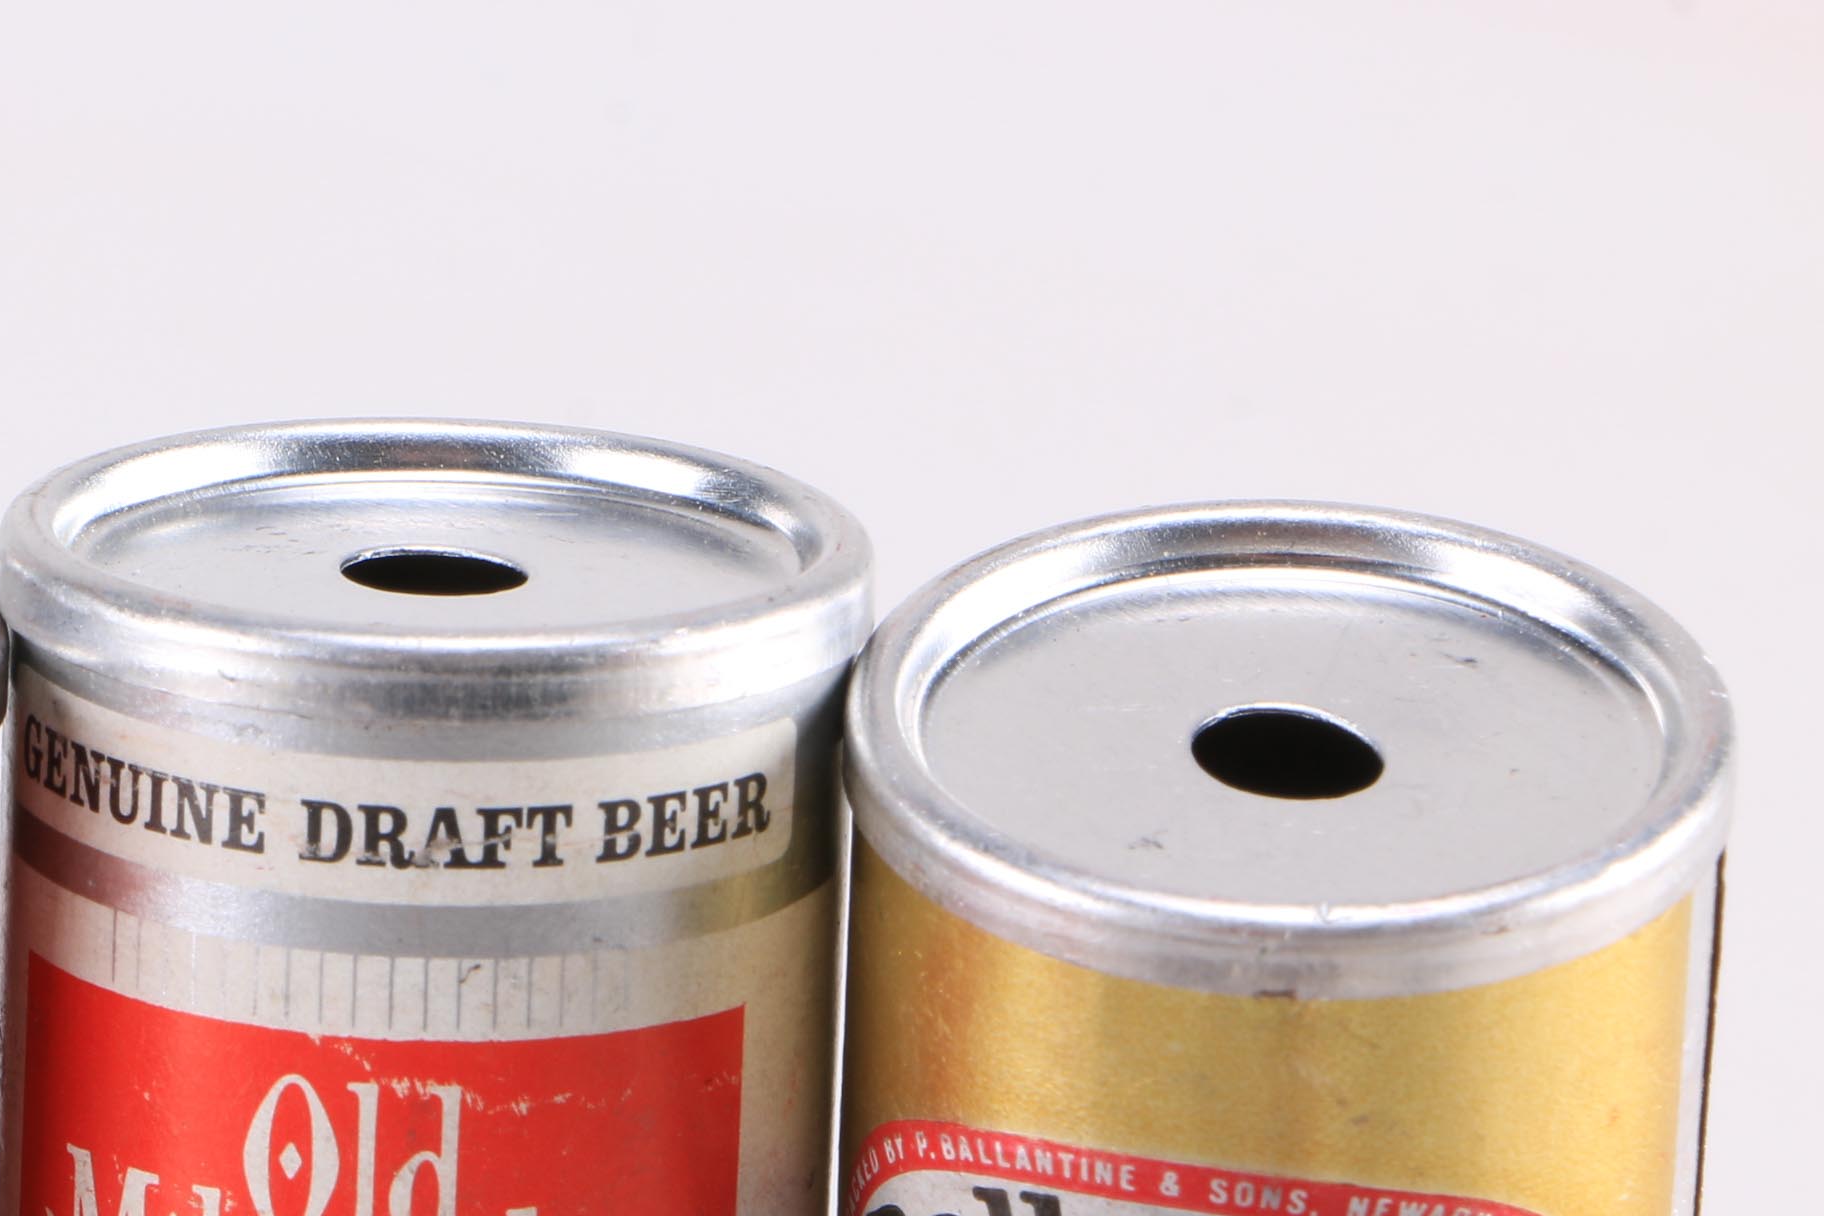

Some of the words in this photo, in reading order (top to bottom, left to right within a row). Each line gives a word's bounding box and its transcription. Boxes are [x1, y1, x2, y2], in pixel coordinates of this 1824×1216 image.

[23, 713, 265, 853] GENUINE
[297, 798, 572, 869] DRAFT
[596, 771, 772, 866] BEER
[883, 1133, 905, 1165] BY
[1159, 1171, 1181, 1198] &
